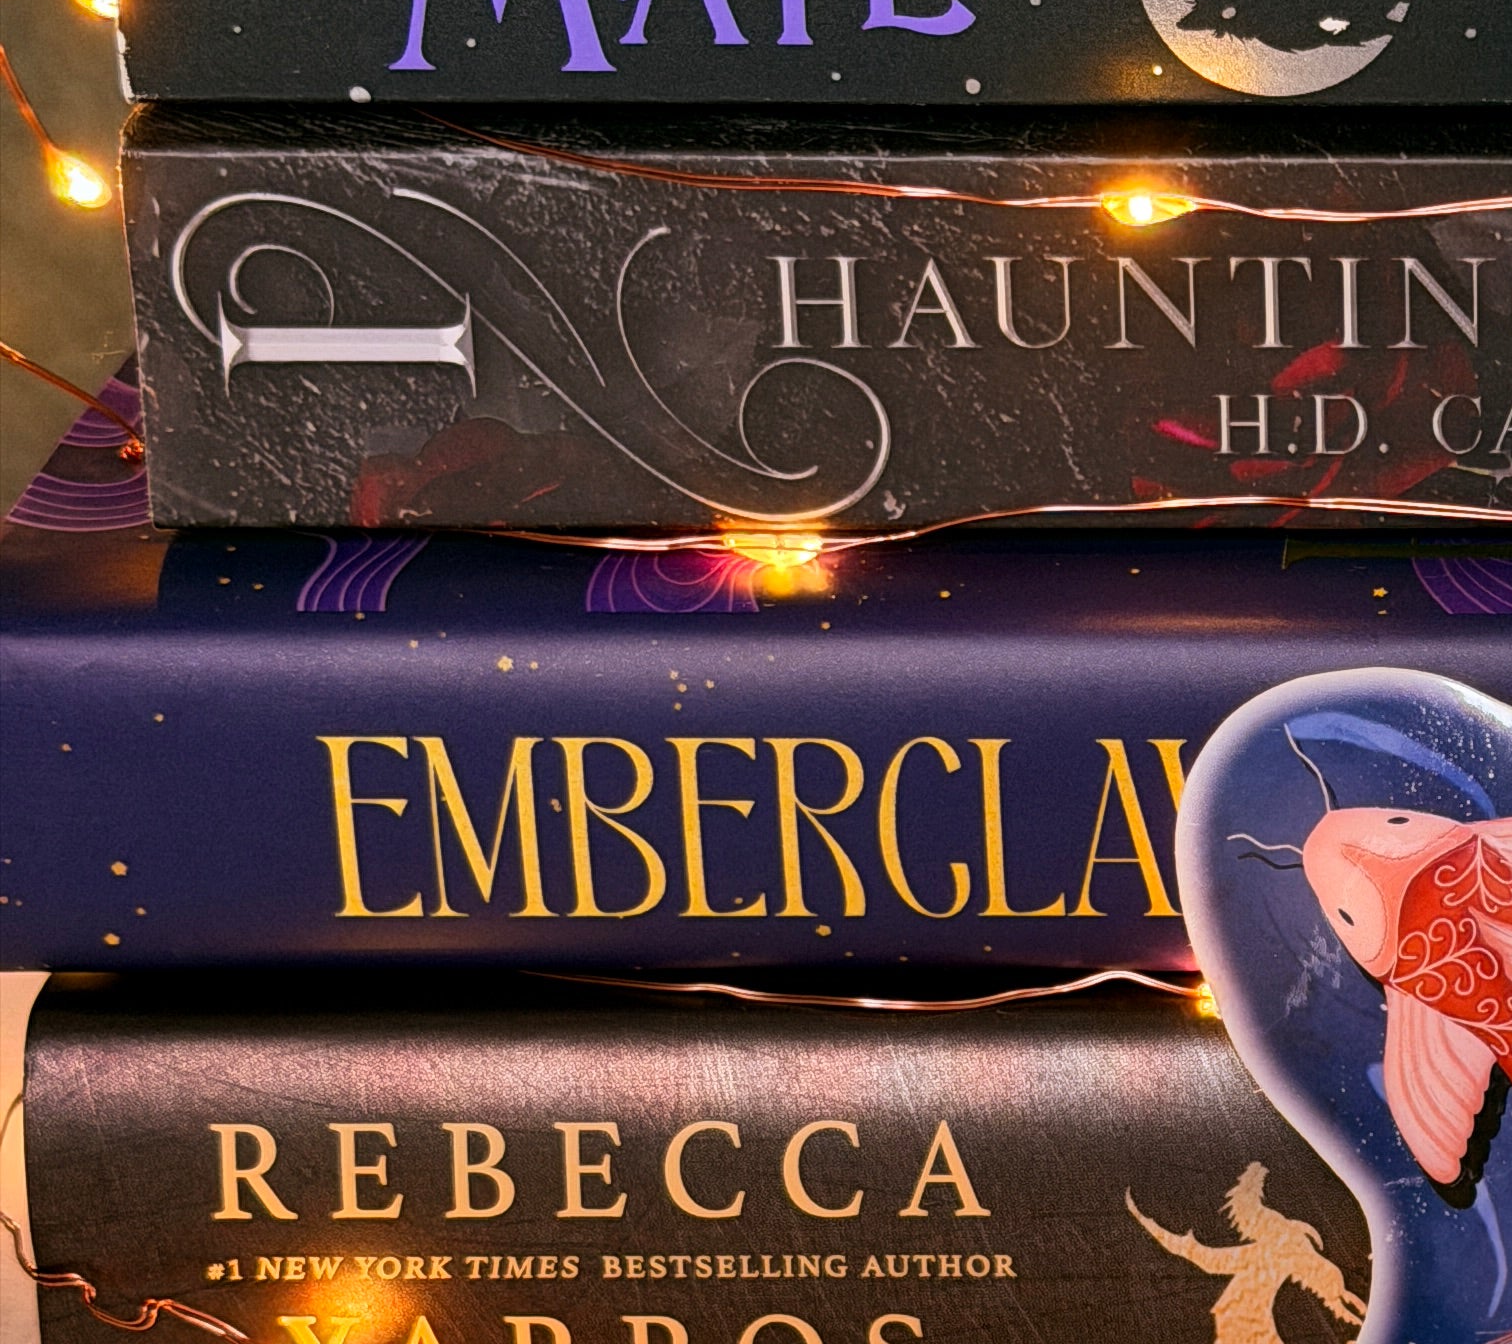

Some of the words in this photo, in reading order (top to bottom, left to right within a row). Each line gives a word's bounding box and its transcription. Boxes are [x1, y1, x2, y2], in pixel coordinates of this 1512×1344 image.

[1213, 393, 1391, 455] H.D.
[315, 736, 1190, 919] EMBERCLA
[208, 1120, 992, 1220] REBECCA
[207, 1257, 244, 1281] #1
[256, 1256, 343, 1280] NEW
[357, 1256, 453, 1280] YORK
[465, 1255, 580, 1280] TIMES
[602, 1254, 848, 1279] BESTSELLING
[861, 1254, 1018, 1279] AUTHOR
